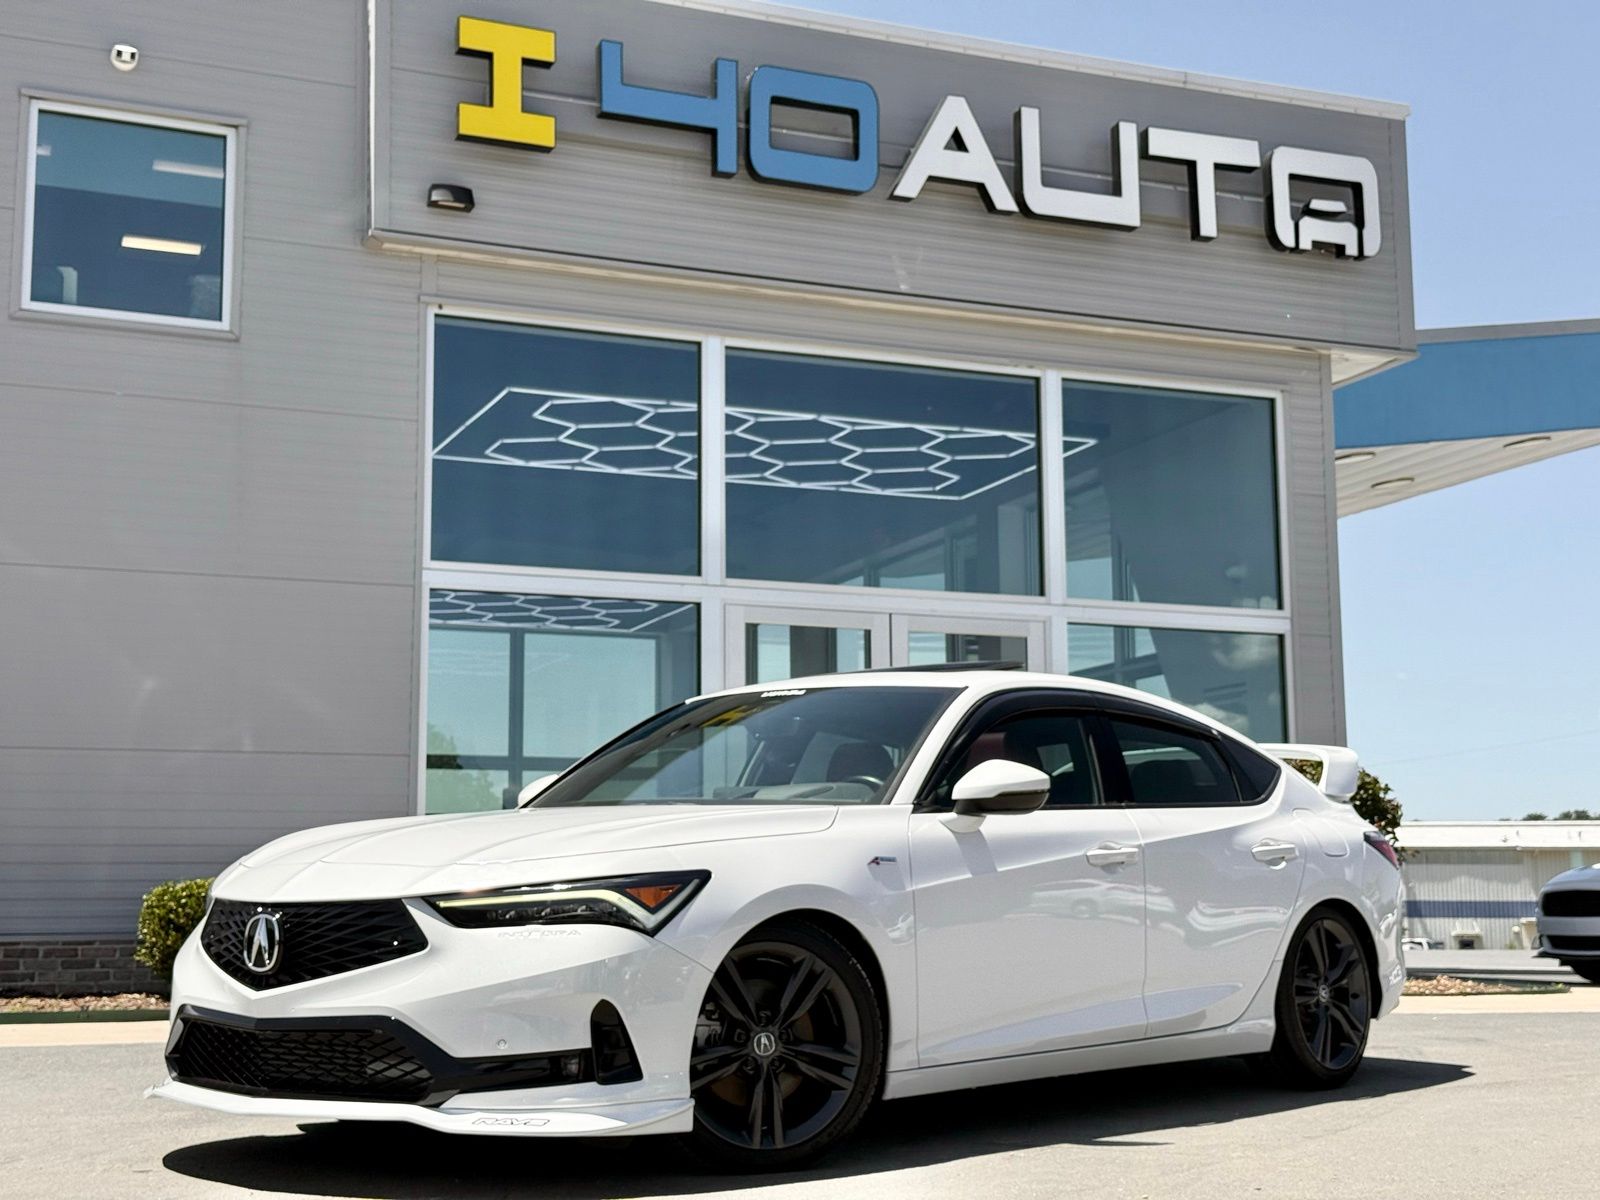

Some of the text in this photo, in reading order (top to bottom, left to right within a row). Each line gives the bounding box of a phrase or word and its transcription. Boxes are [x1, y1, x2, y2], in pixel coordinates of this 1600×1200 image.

[456, 15, 1382, 259] I 40 AUTO
